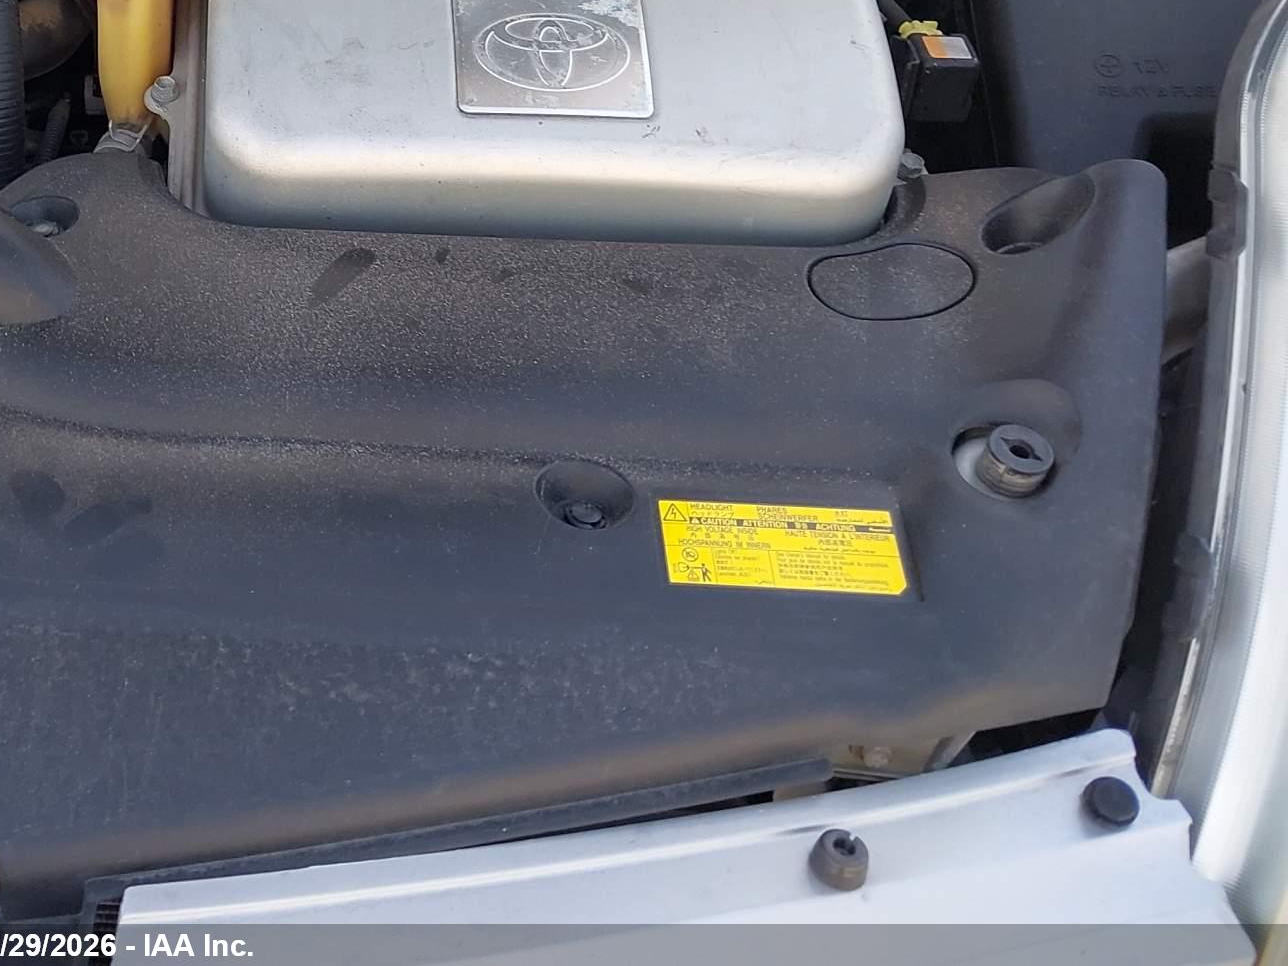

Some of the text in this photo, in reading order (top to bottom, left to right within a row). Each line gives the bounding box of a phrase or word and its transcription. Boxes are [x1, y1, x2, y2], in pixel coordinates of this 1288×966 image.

[690, 503, 788, 514] HEADLIGHT PHARES
[758, 513, 819, 522] SCHEINWERFER
[700, 517, 737, 526] CAUTION
[743, 519, 788, 528] ATTENTION
[815, 523, 856, 532] ACHTUNG
